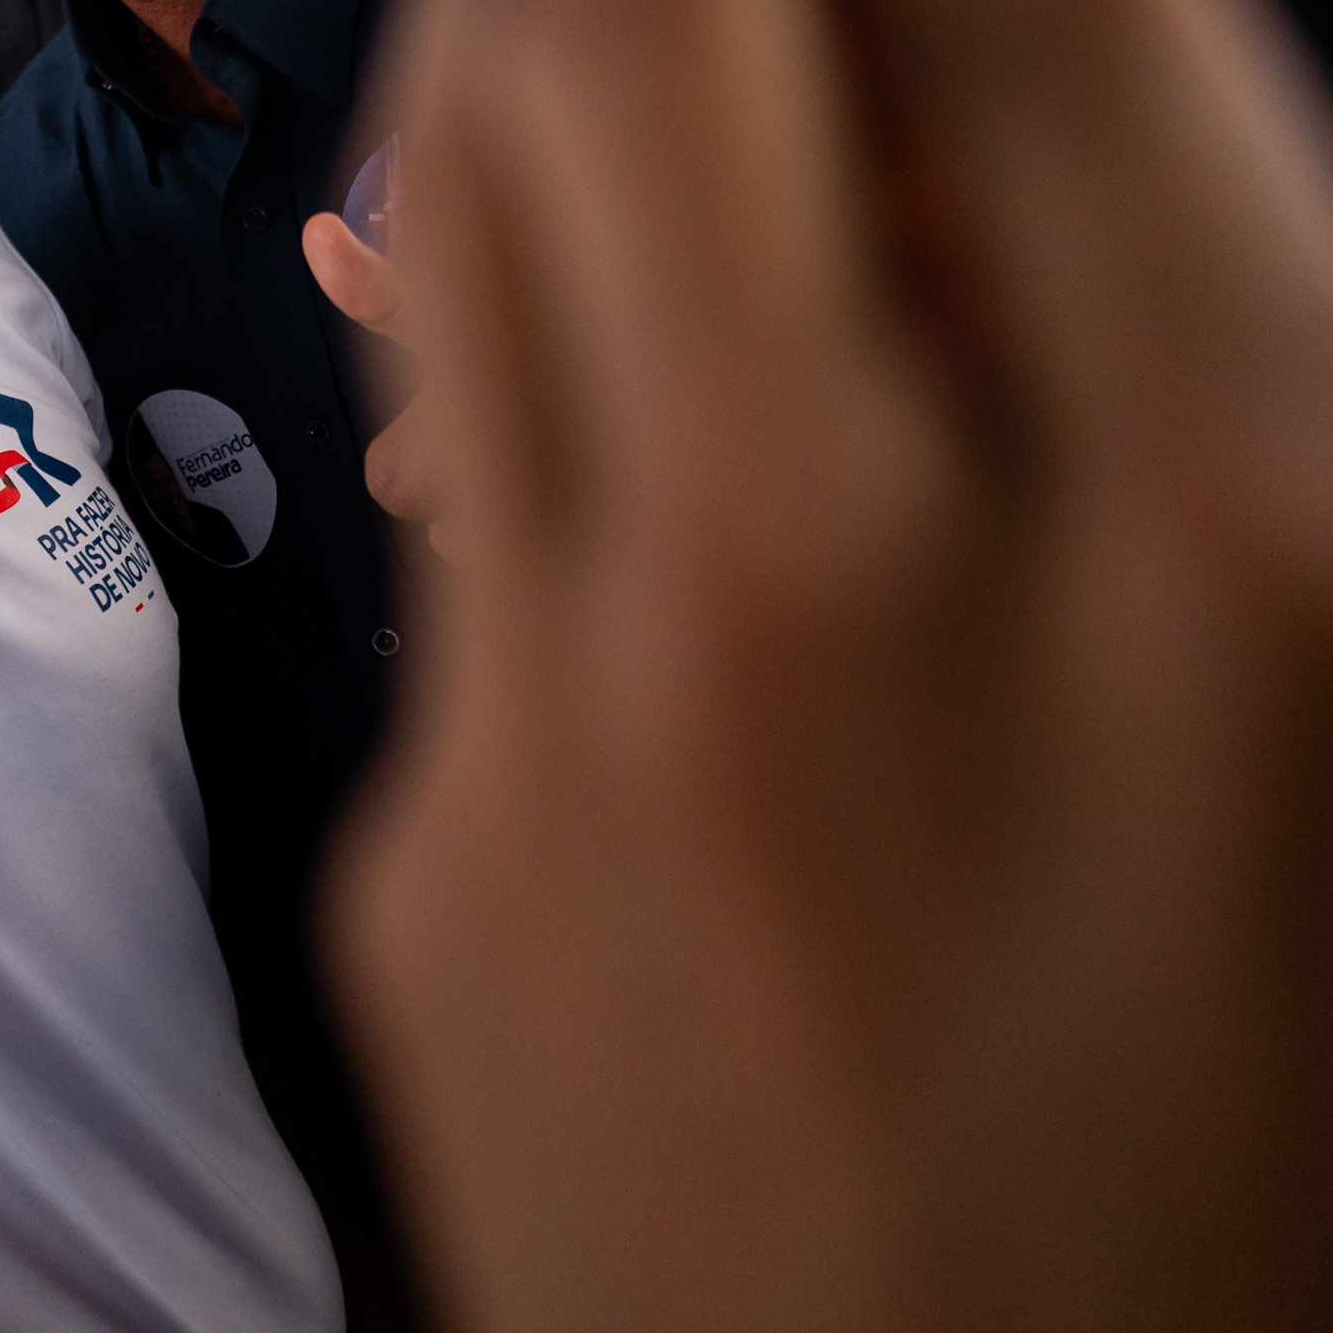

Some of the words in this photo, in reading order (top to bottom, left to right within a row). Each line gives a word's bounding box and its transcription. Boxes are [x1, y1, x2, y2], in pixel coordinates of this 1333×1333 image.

[175, 433, 254, 475] Fernando
[184, 458, 242, 494] Pereira
[37, 516, 87, 561] PRA
[75, 486, 116, 532] FAZER
[65, 514, 135, 585] HISTÓRIA
[89, 574, 123, 613] DE
[114, 542, 151, 594] NOVO
